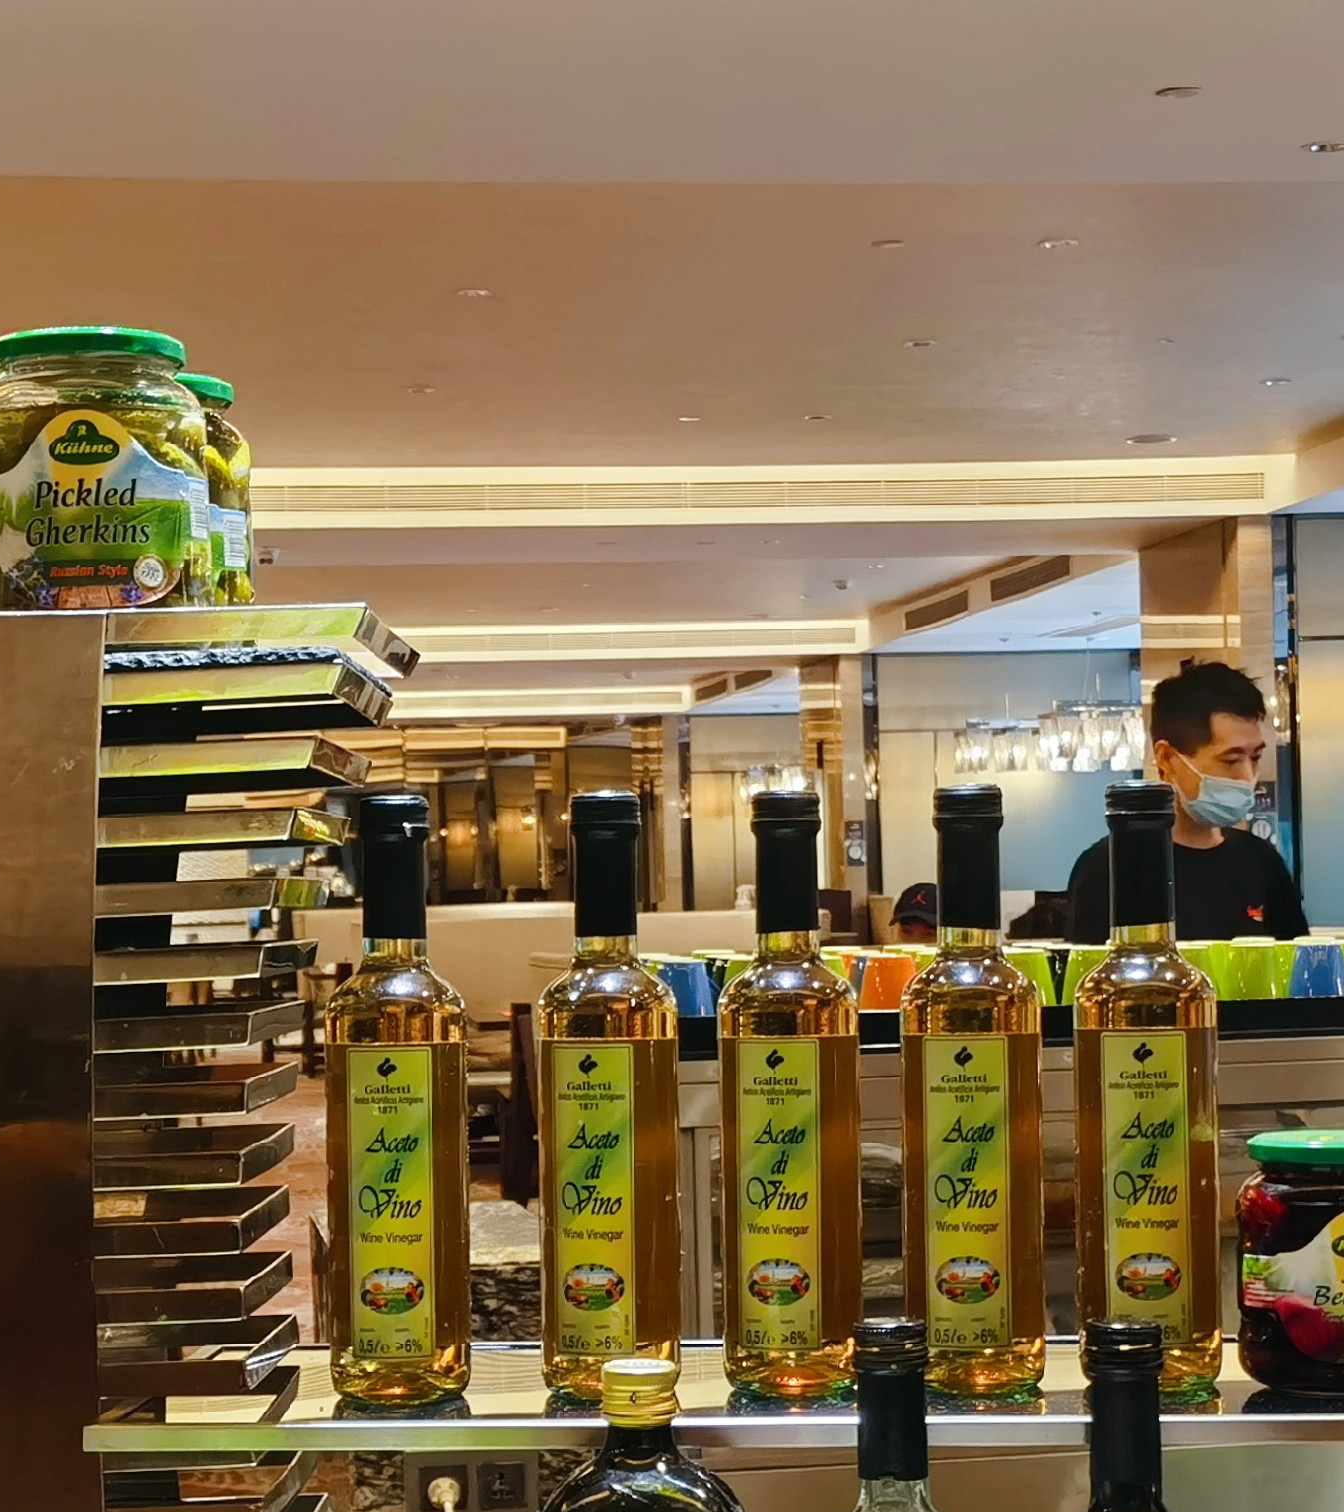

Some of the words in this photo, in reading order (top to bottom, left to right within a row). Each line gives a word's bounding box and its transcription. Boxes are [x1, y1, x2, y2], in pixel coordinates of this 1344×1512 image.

[54, 441, 114, 455] Kühne
[35, 478, 137, 509] Pickled
[26, 515, 150, 547] Gherkins
[566, 1081, 612, 1091] Galletti
[753, 1076, 798, 1086] Galletti
[941, 1074, 987, 1083] Galletti
[1119, 1070, 1167, 1080] Galletti
[364, 1084, 411, 1095] Galletti
[567, 1123, 620, 1149] Aceto
[754, 1118, 806, 1144] Aceto
[942, 1115, 995, 1143] Aceto
[1121, 1111, 1175, 1139] Aceto
[365, 1126, 419, 1153] Aceto
[584, 1155, 603, 1180] di
[771, 1150, 789, 1175] di
[961, 1147, 979, 1173] di
[1141, 1144, 1159, 1169] di
[384, 1158, 403, 1183] di
[562, 1181, 623, 1215] Vino
[746, 1176, 809, 1210] Vino
[934, 1174, 998, 1209] Vino
[1113, 1170, 1178, 1206] Vino
[359, 1185, 422, 1219] Vino
[563, 1227, 584, 1239] Wine
[586, 1228, 624, 1242] Vinegar
[747, 1222, 770, 1235] Wine
[771, 1223, 810, 1238] Vinegar
[936, 1221, 960, 1232] Wine
[961, 1221, 999, 1235] Vinegar
[1115, 1218, 1140, 1229] Wine
[1142, 1218, 1179, 1231] Vinegar
[360, 1232, 383, 1243] Wine
[385, 1232, 423, 1245] Vinegar
